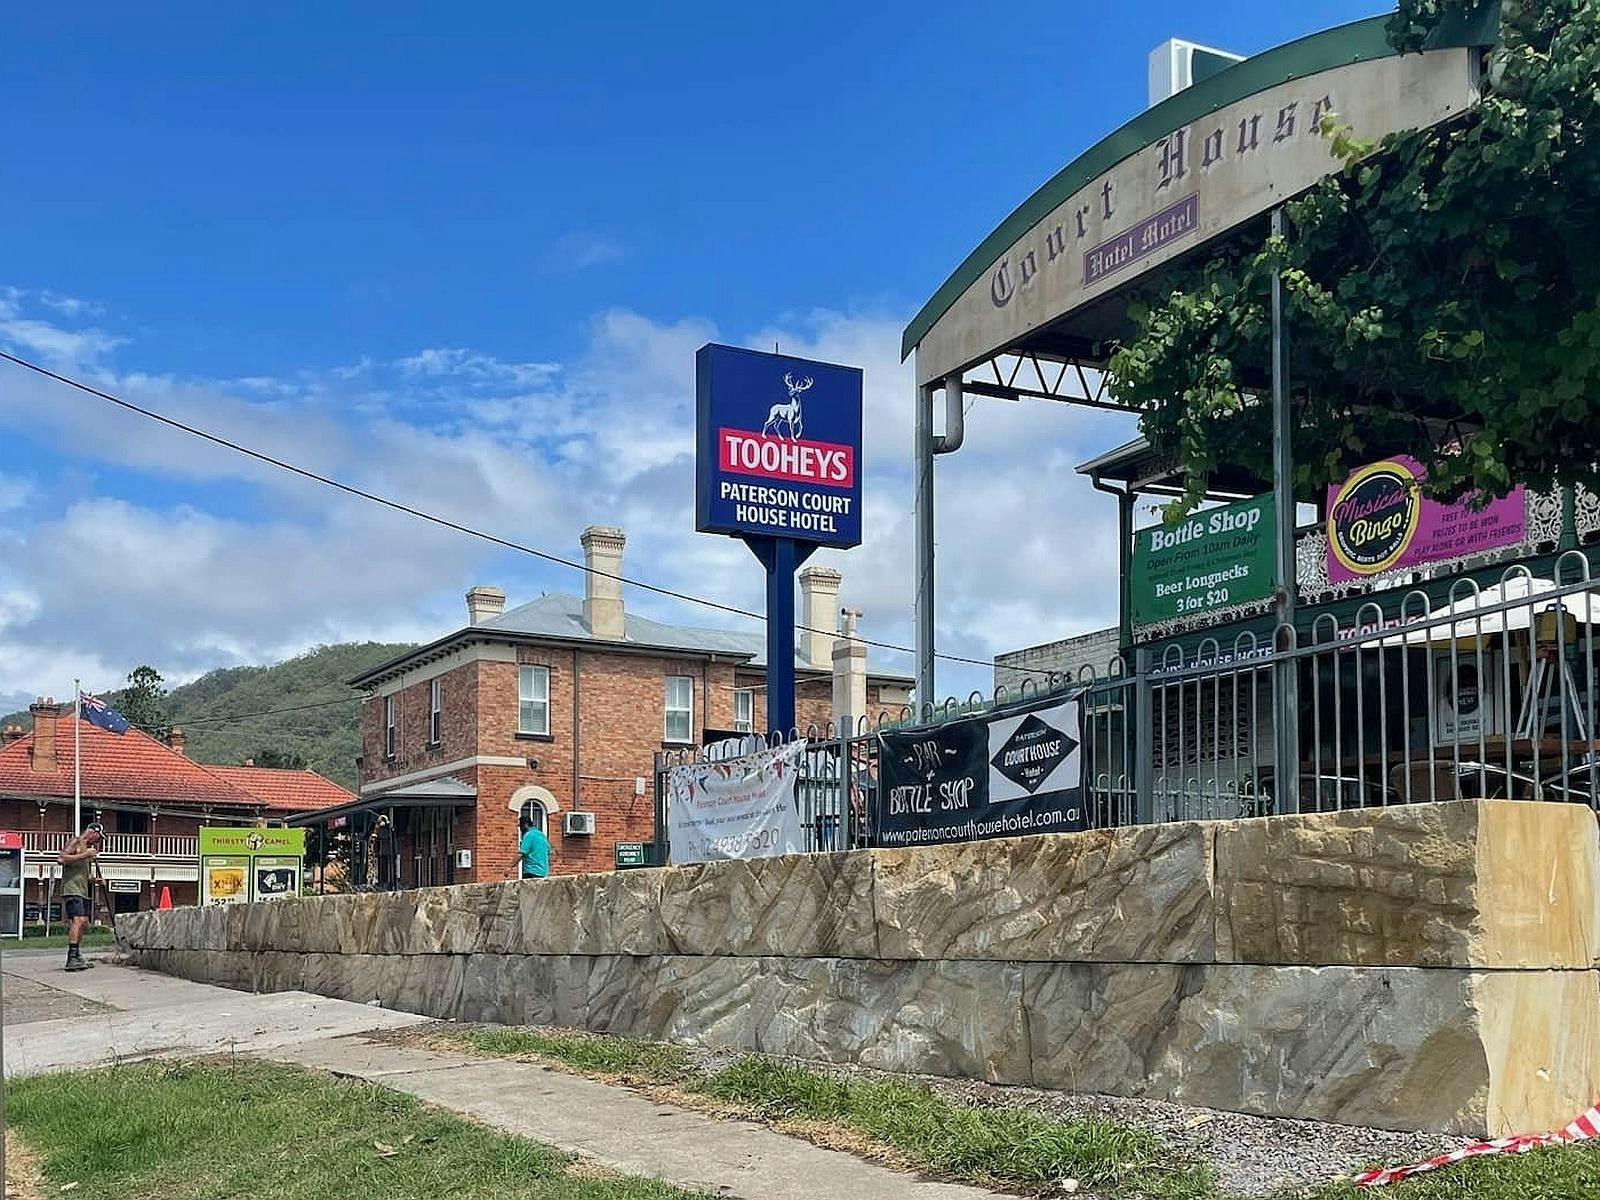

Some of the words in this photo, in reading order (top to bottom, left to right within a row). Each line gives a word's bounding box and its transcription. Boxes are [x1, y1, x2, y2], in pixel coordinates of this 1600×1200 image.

[992, 180, 1114, 307] Court
[1090, 237, 1133, 278] Hotel
[1141, 206, 1191, 250] Motel
[726, 435, 847, 480] TOOHEYS
[721, 482, 798, 508] PATERSON
[802, 493, 851, 514] COURT
[1334, 490, 1407, 525] Musica
[736, 504, 787, 527] HOUSE
[791, 511, 837, 532] HOTEL
[1150, 520, 1204, 551] Bottle
[1208, 508, 1260, 534] Shop
[1147, 556, 1172, 570] Open
[1175, 548, 1200, 562] From
[1155, 582, 1183, 597] Beer
[1185, 564, 1249, 588] Longnecks
[1176, 598, 1184, 611] 3
[1185, 596, 1203, 610] for
[1206, 588, 1228, 606] $20
[1237, 647, 1272, 661] HOTE
[890, 784, 932, 815] BOTTLE
[940, 777, 974, 810] SHOP
[212, 837, 244, 846] THIRSTY
[264, 837, 290, 845] CAMEL
